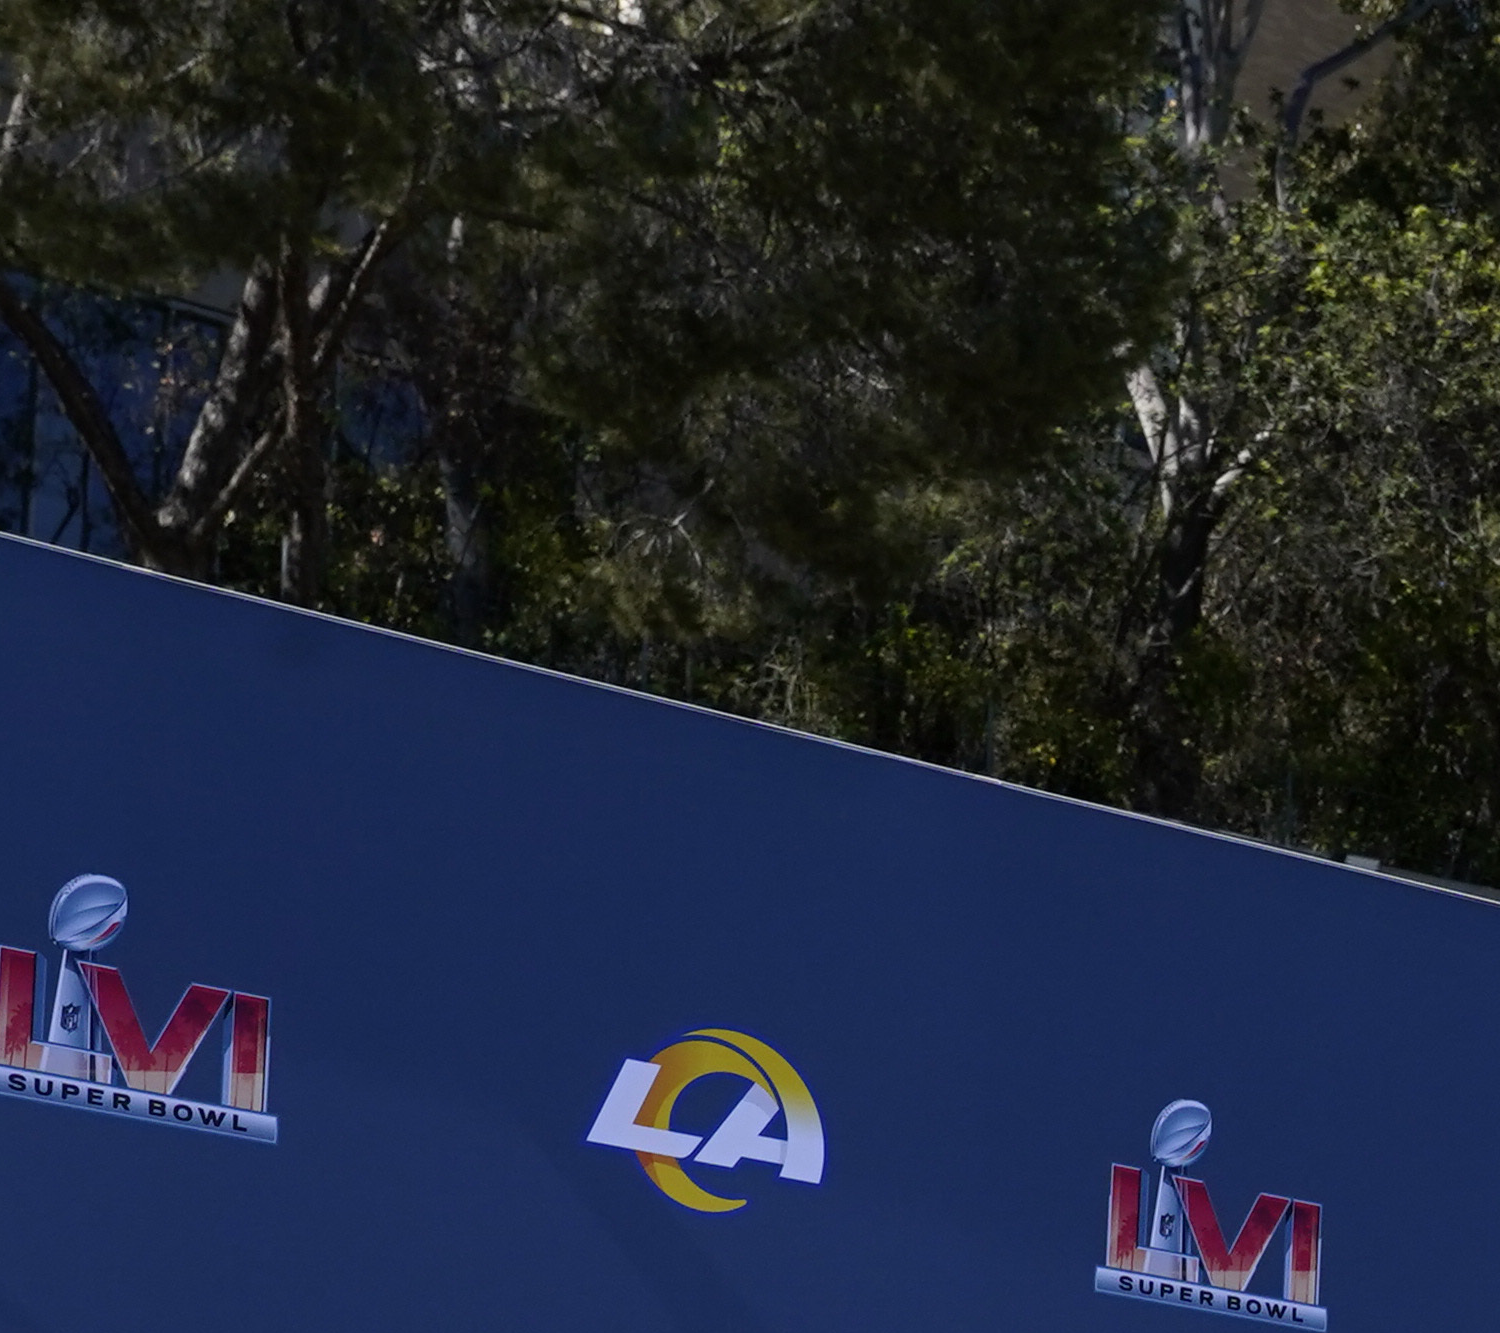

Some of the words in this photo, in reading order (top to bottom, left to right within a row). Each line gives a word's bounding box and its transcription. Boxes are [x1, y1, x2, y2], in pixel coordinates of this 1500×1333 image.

[7, 1071, 132, 1112] SUPER
[148, 1097, 249, 1133] BOWL
[585, 1029, 823, 1184] LA
[1106, 1164, 1321, 1304] LVI
[1118, 1274, 1215, 1307] SUPER
[1226, 1293, 1305, 1323] BOWL
